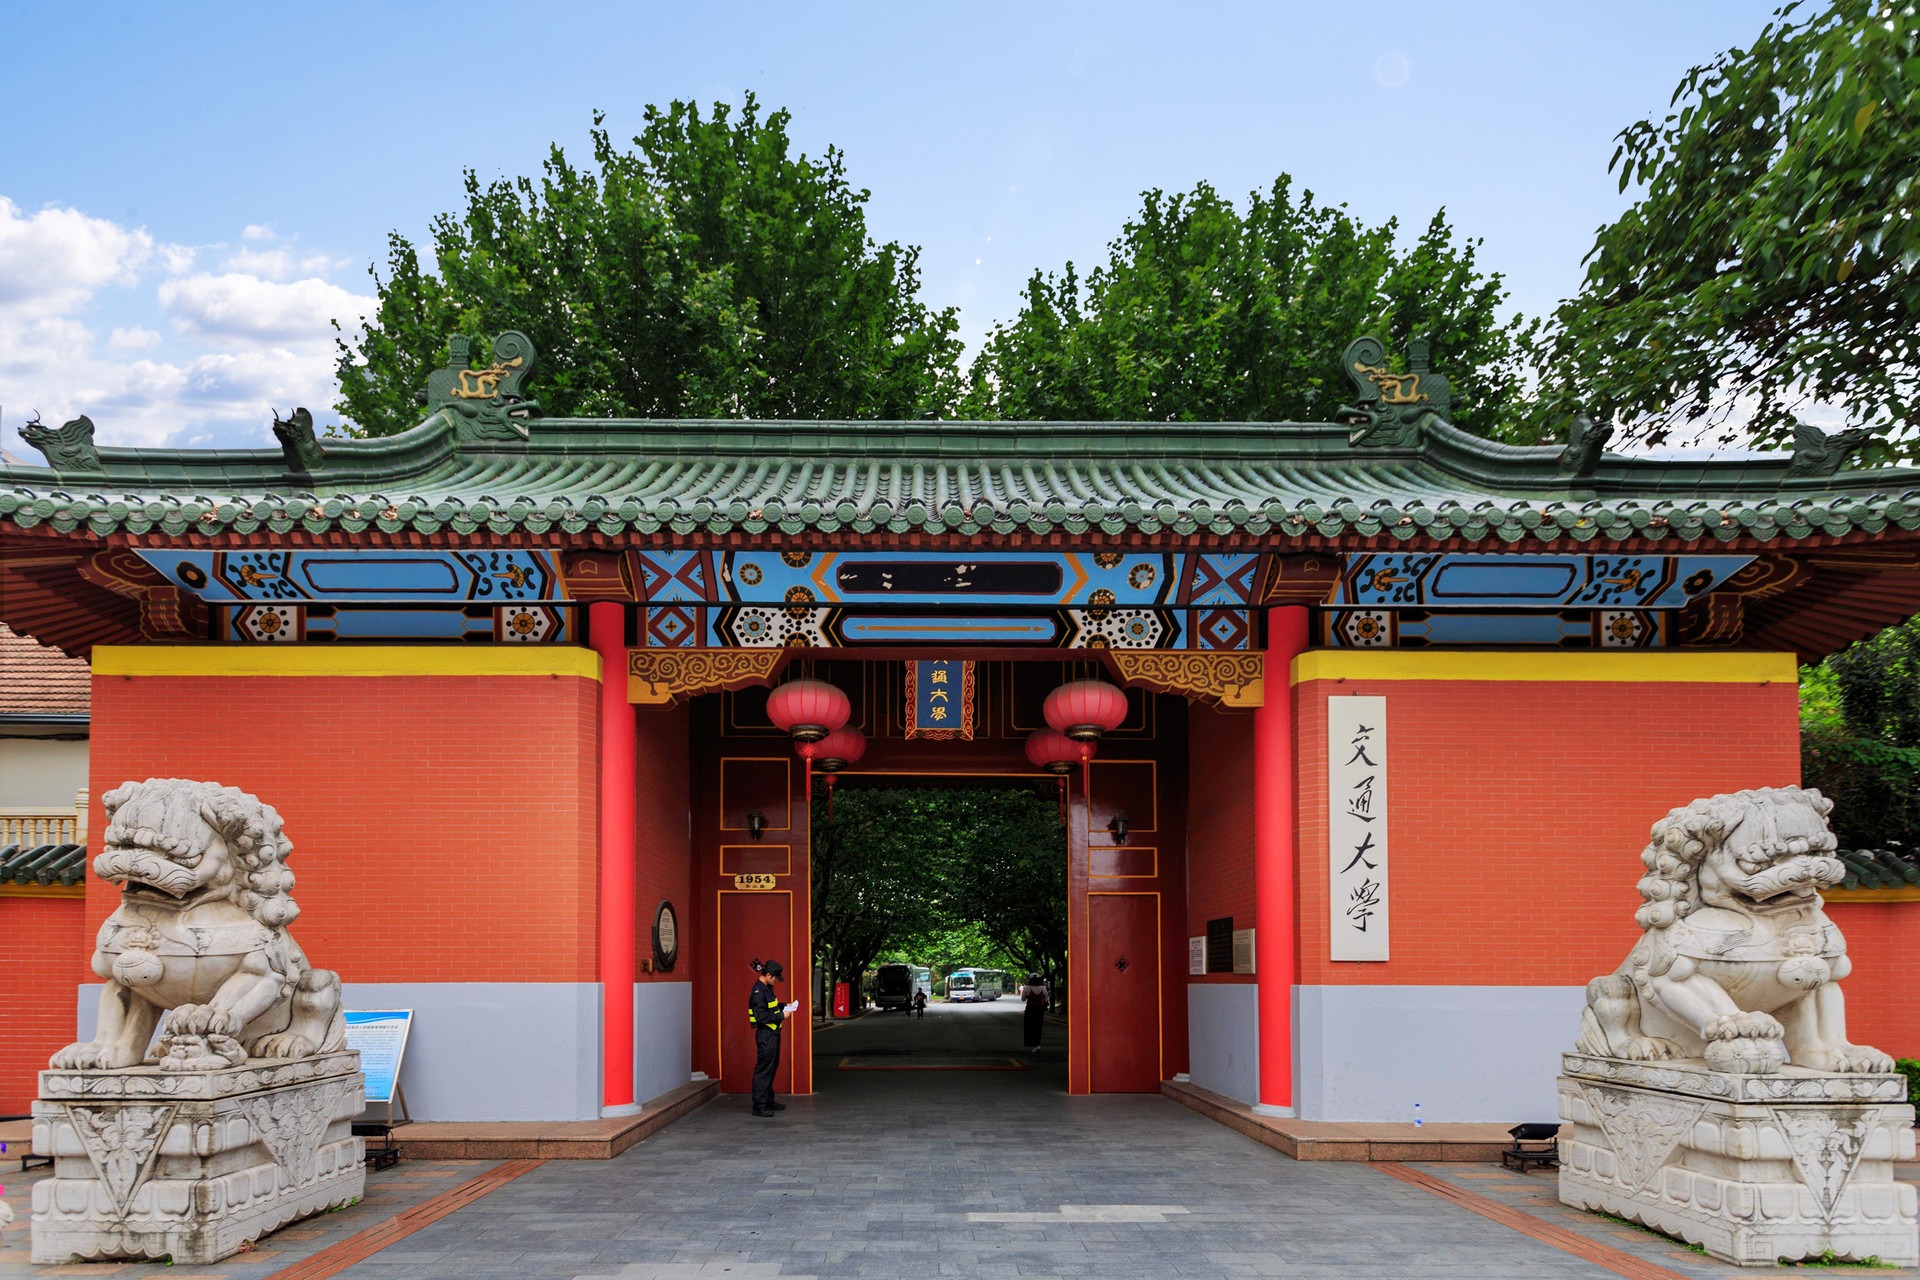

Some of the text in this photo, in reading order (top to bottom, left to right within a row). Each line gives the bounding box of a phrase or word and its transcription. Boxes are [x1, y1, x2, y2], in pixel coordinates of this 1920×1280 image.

[930, 660, 948, 721] 通大學
[1340, 724, 1380, 932] 交通大學
[739, 875, 771, 884] 1954
